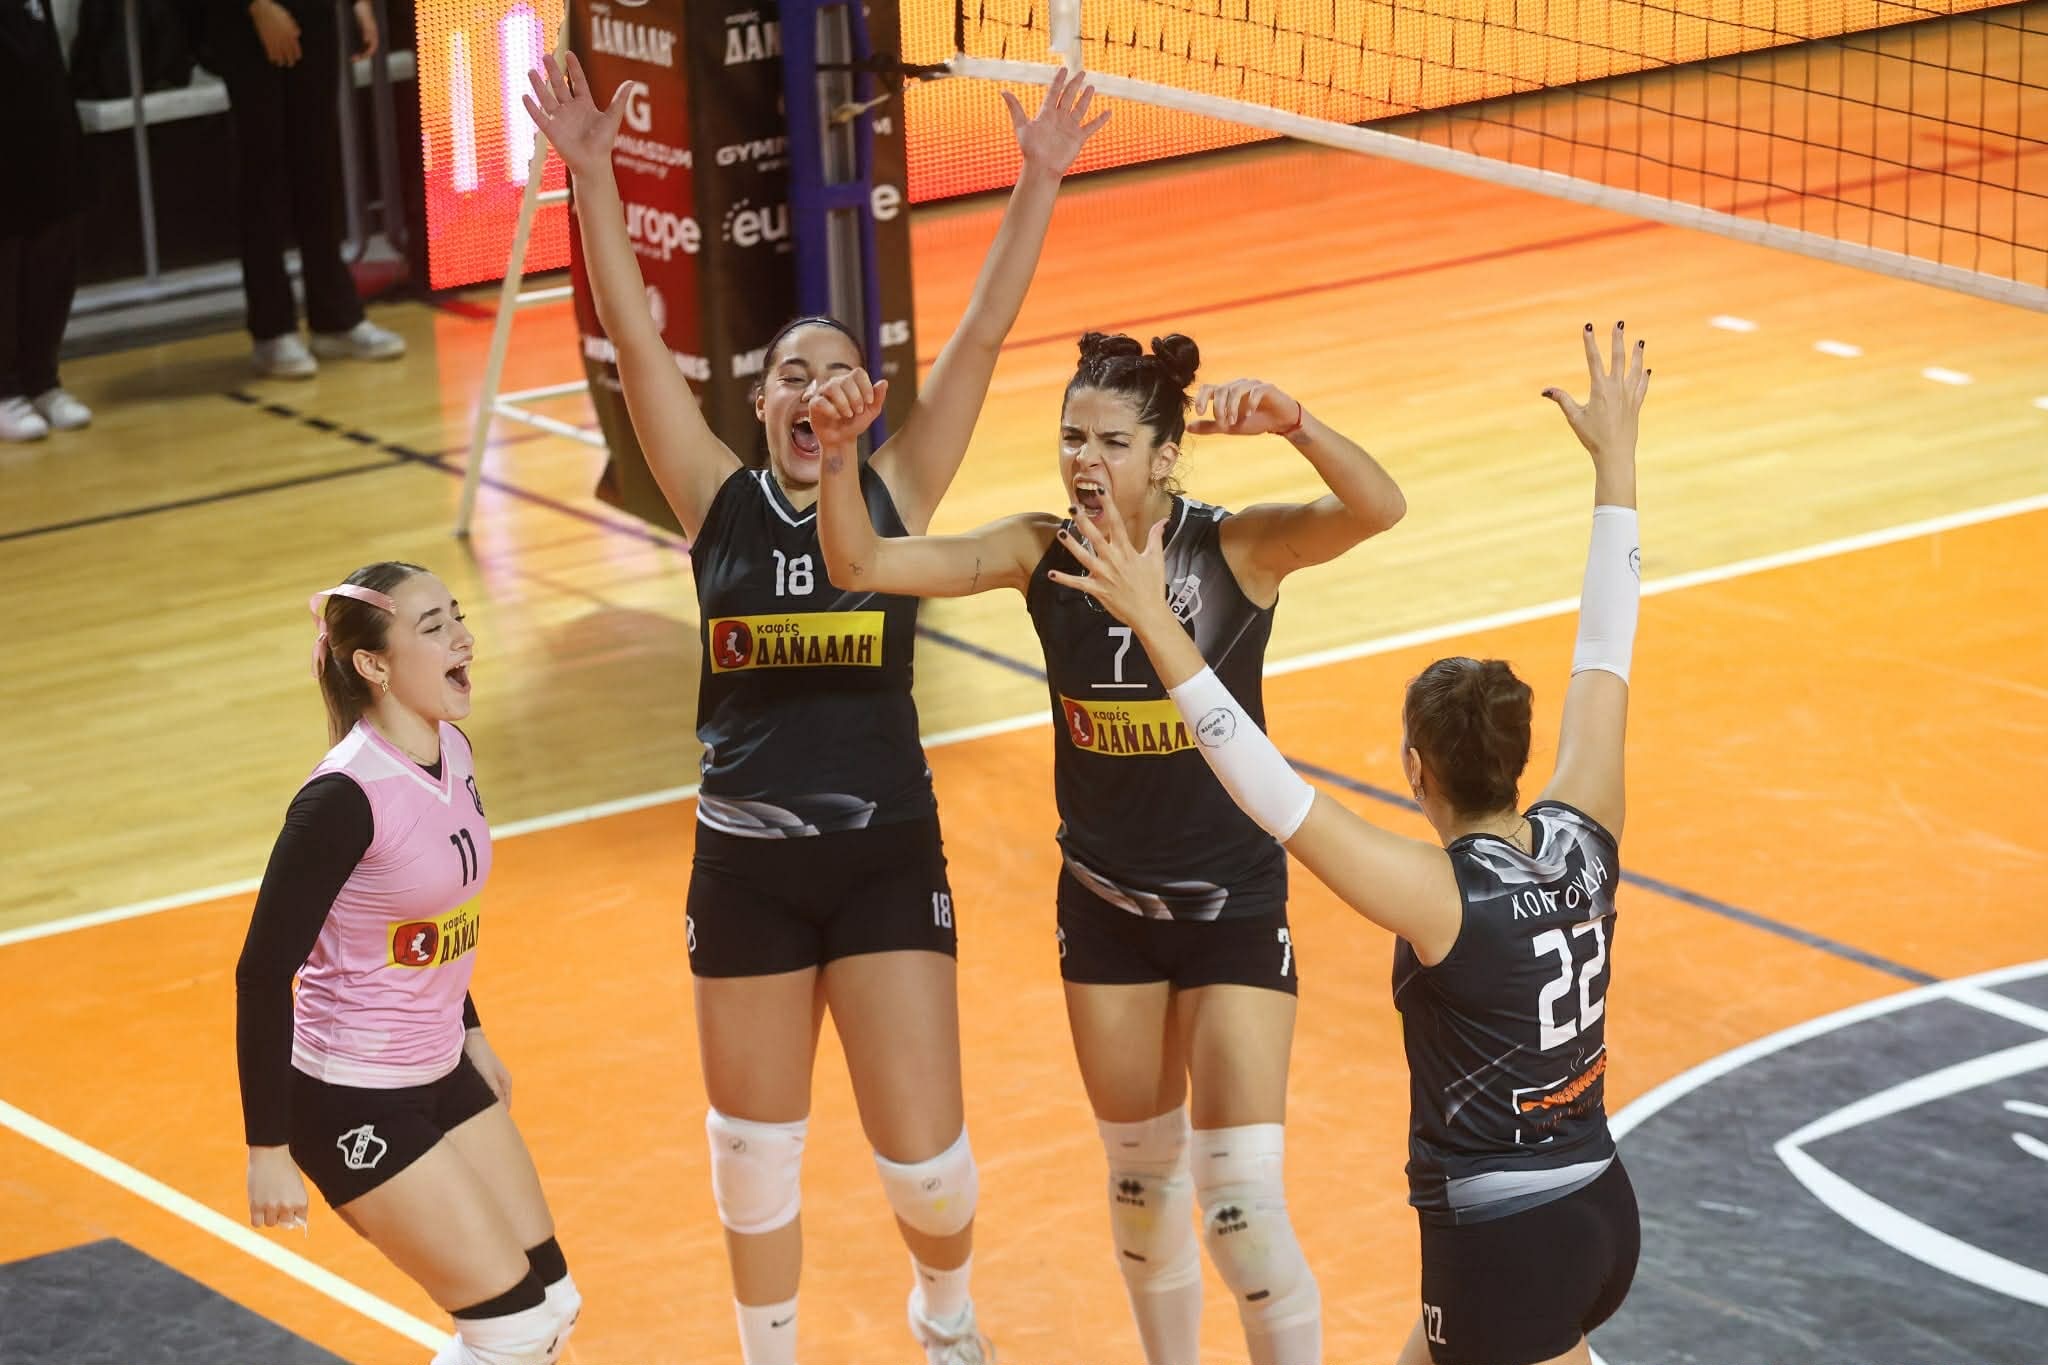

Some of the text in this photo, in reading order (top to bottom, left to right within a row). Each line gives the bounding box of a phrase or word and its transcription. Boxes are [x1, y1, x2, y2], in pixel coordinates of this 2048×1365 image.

[773, 549, 814, 597] 18
[756, 618, 801, 637] καφές
[755, 634, 874, 666] ΔΑΝΔΑΛΗ
[1107, 626, 1132, 683] 7
[1092, 705, 1131, 725] καφές
[1097, 721, 1195, 754] ΔΑΝΔΑΛ
[449, 828, 478, 888] 11
[931, 891, 953, 928] 18
[1277, 927, 1293, 977] 7
[1531, 912, 1607, 1052] 22
[1423, 1302, 1448, 1345] 22
